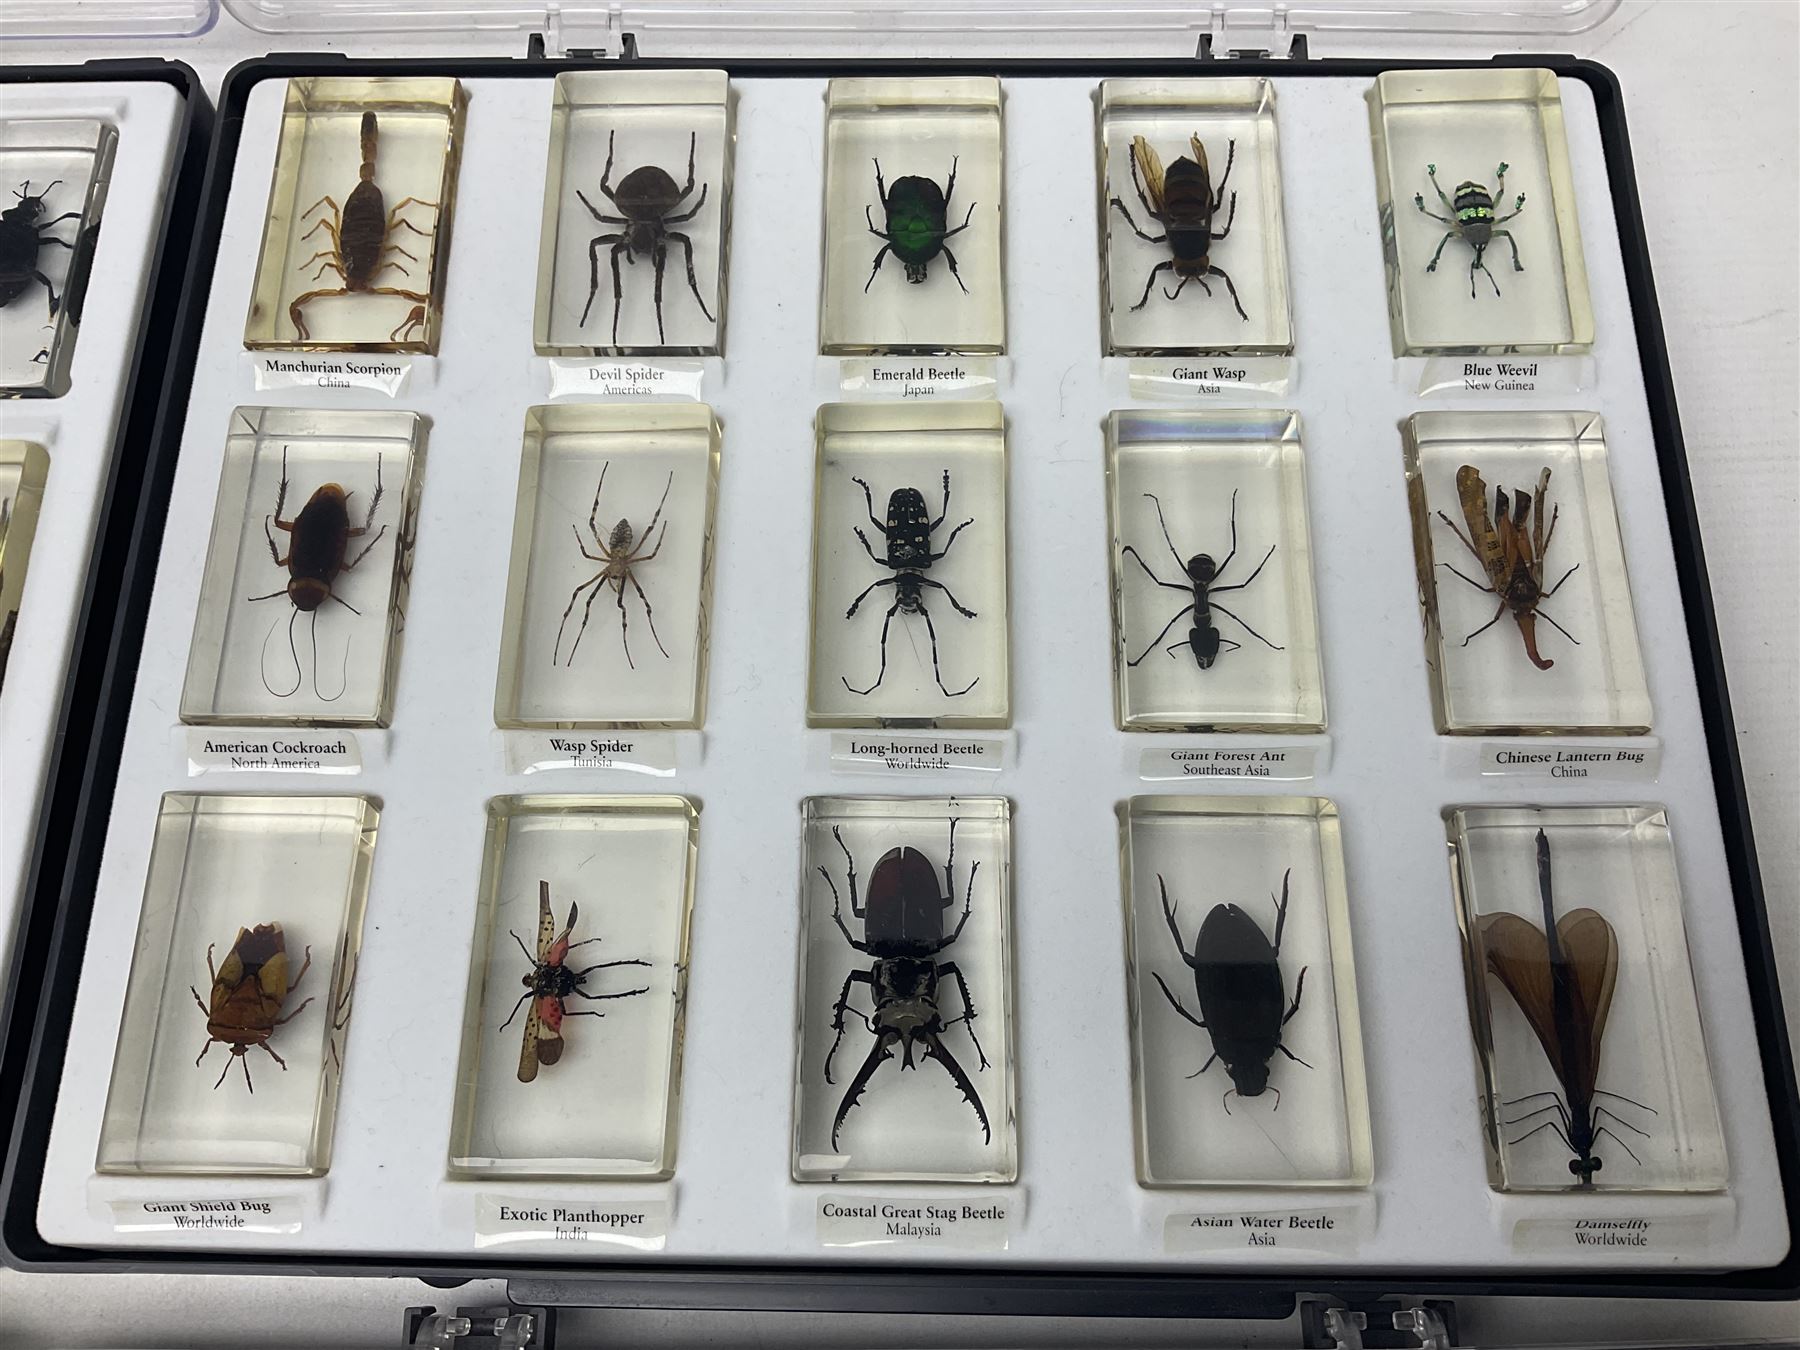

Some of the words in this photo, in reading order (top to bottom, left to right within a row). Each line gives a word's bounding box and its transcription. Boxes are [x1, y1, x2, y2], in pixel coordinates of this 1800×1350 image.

[266, 360, 342, 374] Manchurian
[346, 363, 401, 377] Scorpion
[873, 369, 923, 380] Emerald
[928, 369, 965, 380] Beetle
[1173, 368, 1208, 379] Giant
[1213, 368, 1246, 381] Wasp
[1464, 364, 1492, 376] Blue
[1497, 364, 1538, 376] Weevil
[589, 369, 622, 380] Devil
[626, 369, 664, 382] Spider
[318, 378, 350, 388] China
[1198, 384, 1220, 393] Asia
[1465, 380, 1491, 390] New
[1494, 380, 1534, 390] Guinea
[603, 384, 652, 395] Americas
[903, 384, 934, 397] Japan
[204, 741, 268, 753] American
[273, 741, 346, 753] Cockroach
[550, 739, 586, 752] Wasp
[591, 740, 633, 754] Spider
[851, 742, 938, 756] Long-horned
[943, 744, 983, 754] Beetle
[570, 756, 612, 767] Tunisia
[1171, 752, 1209, 760] Giant
[1214, 752, 1255, 761] Forest
[1260, 752, 1285, 761] Ant
[1496, 752, 1552, 763] Chinese
[1557, 752, 1611, 762] Lantern
[1617, 752, 1644, 763] Bug
[231, 758, 267, 768] North
[271, 758, 320, 769] America
[885, 758, 950, 769] Worldwide
[1183, 764, 1241, 776] Southeast
[1245, 766, 1270, 776] Asia
[1551, 767, 1587, 777] China
[144, 1203, 186, 1212] Giant
[190, 1202, 236, 1212] Shield
[241, 1202, 271, 1213] Bug
[823, 1204, 876, 1218] Coastal
[882, 1206, 921, 1218] Great
[926, 1207, 957, 1222] Stag
[962, 1206, 1005, 1219] Beetle
[174, 1215, 244, 1228] Worldwide
[500, 1207, 547, 1221] Exotic
[553, 1209, 644, 1227] Planthopper
[1190, 1217, 1233, 1227] Asian
[1240, 1217, 1284, 1228] Water
[1289, 1217, 1334, 1229] Beetle
[556, 1227, 588, 1240] India
[886, 1223, 941, 1238] Malaysia
[1248, 1233, 1276, 1246] Asia
[1575, 1233, 1647, 1246] Worldwide
